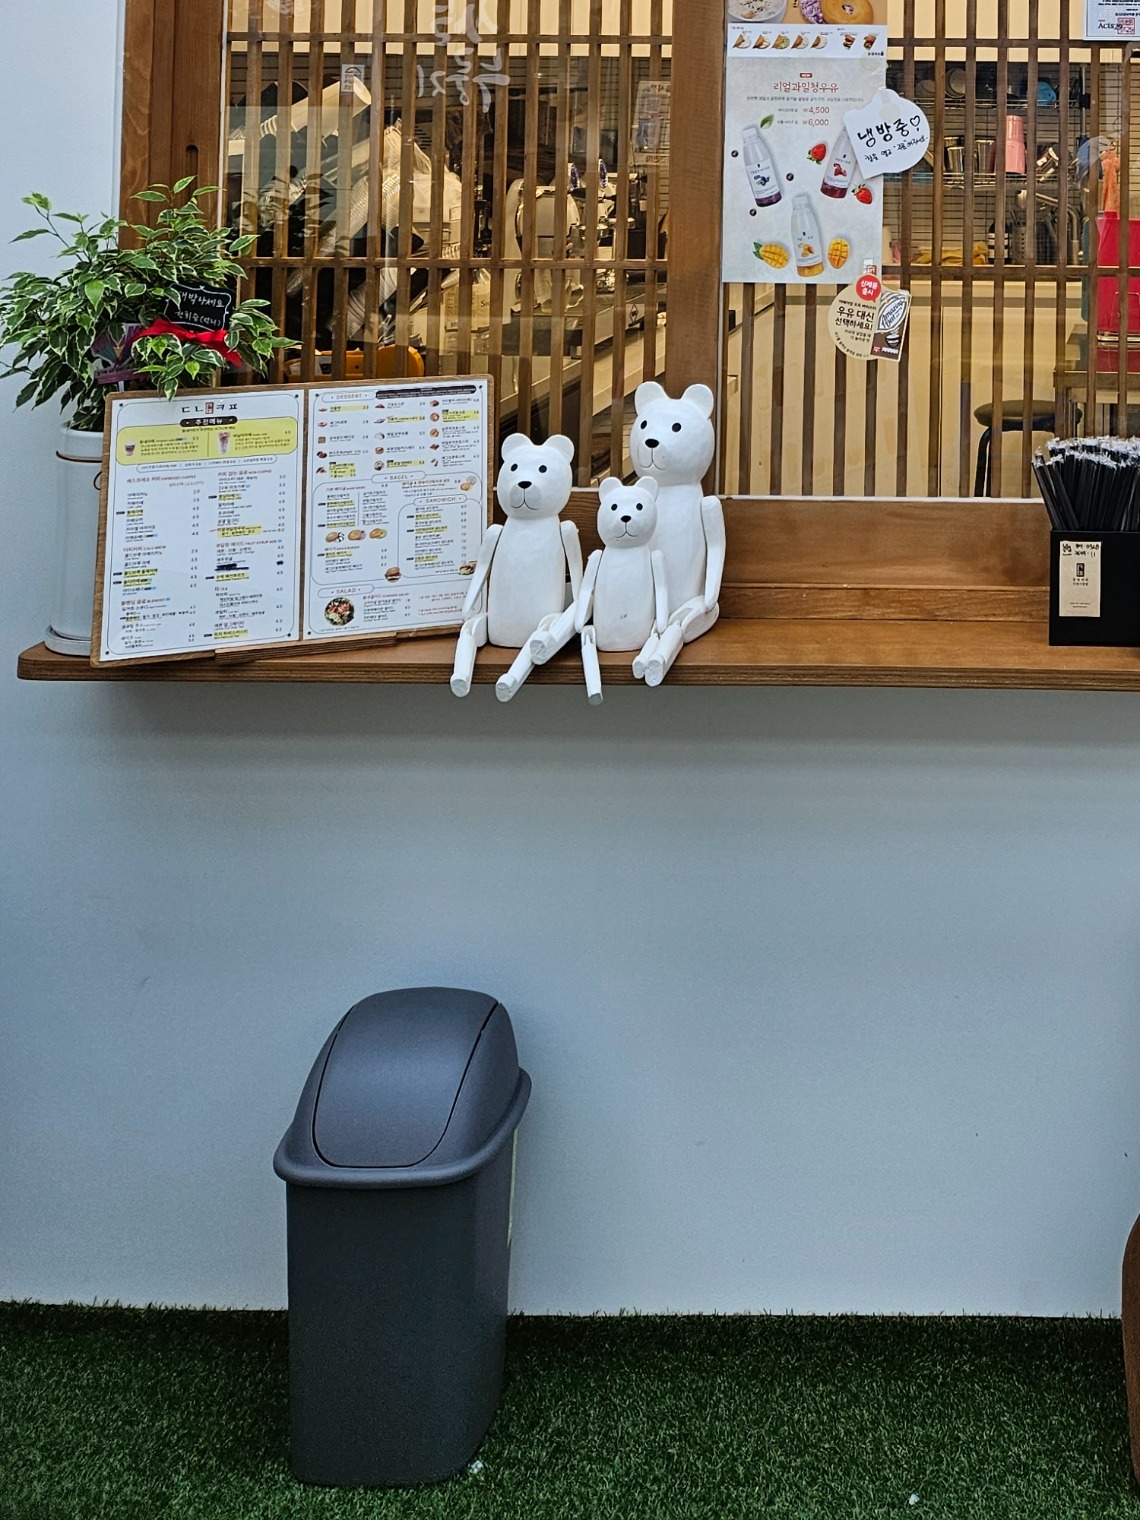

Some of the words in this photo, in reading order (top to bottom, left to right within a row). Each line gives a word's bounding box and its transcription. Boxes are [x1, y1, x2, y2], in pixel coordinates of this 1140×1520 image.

[773, 81, 839, 93] 리얼과일청우유
[857, 118, 910, 148] 냉방중
[860, 280, 878, 290] 신제품
[861, 288, 874, 296] 출시
[836, 306, 855, 318] 우유
[856, 310, 875, 323] 대신
[835, 317, 873, 331] 선택하세요!
